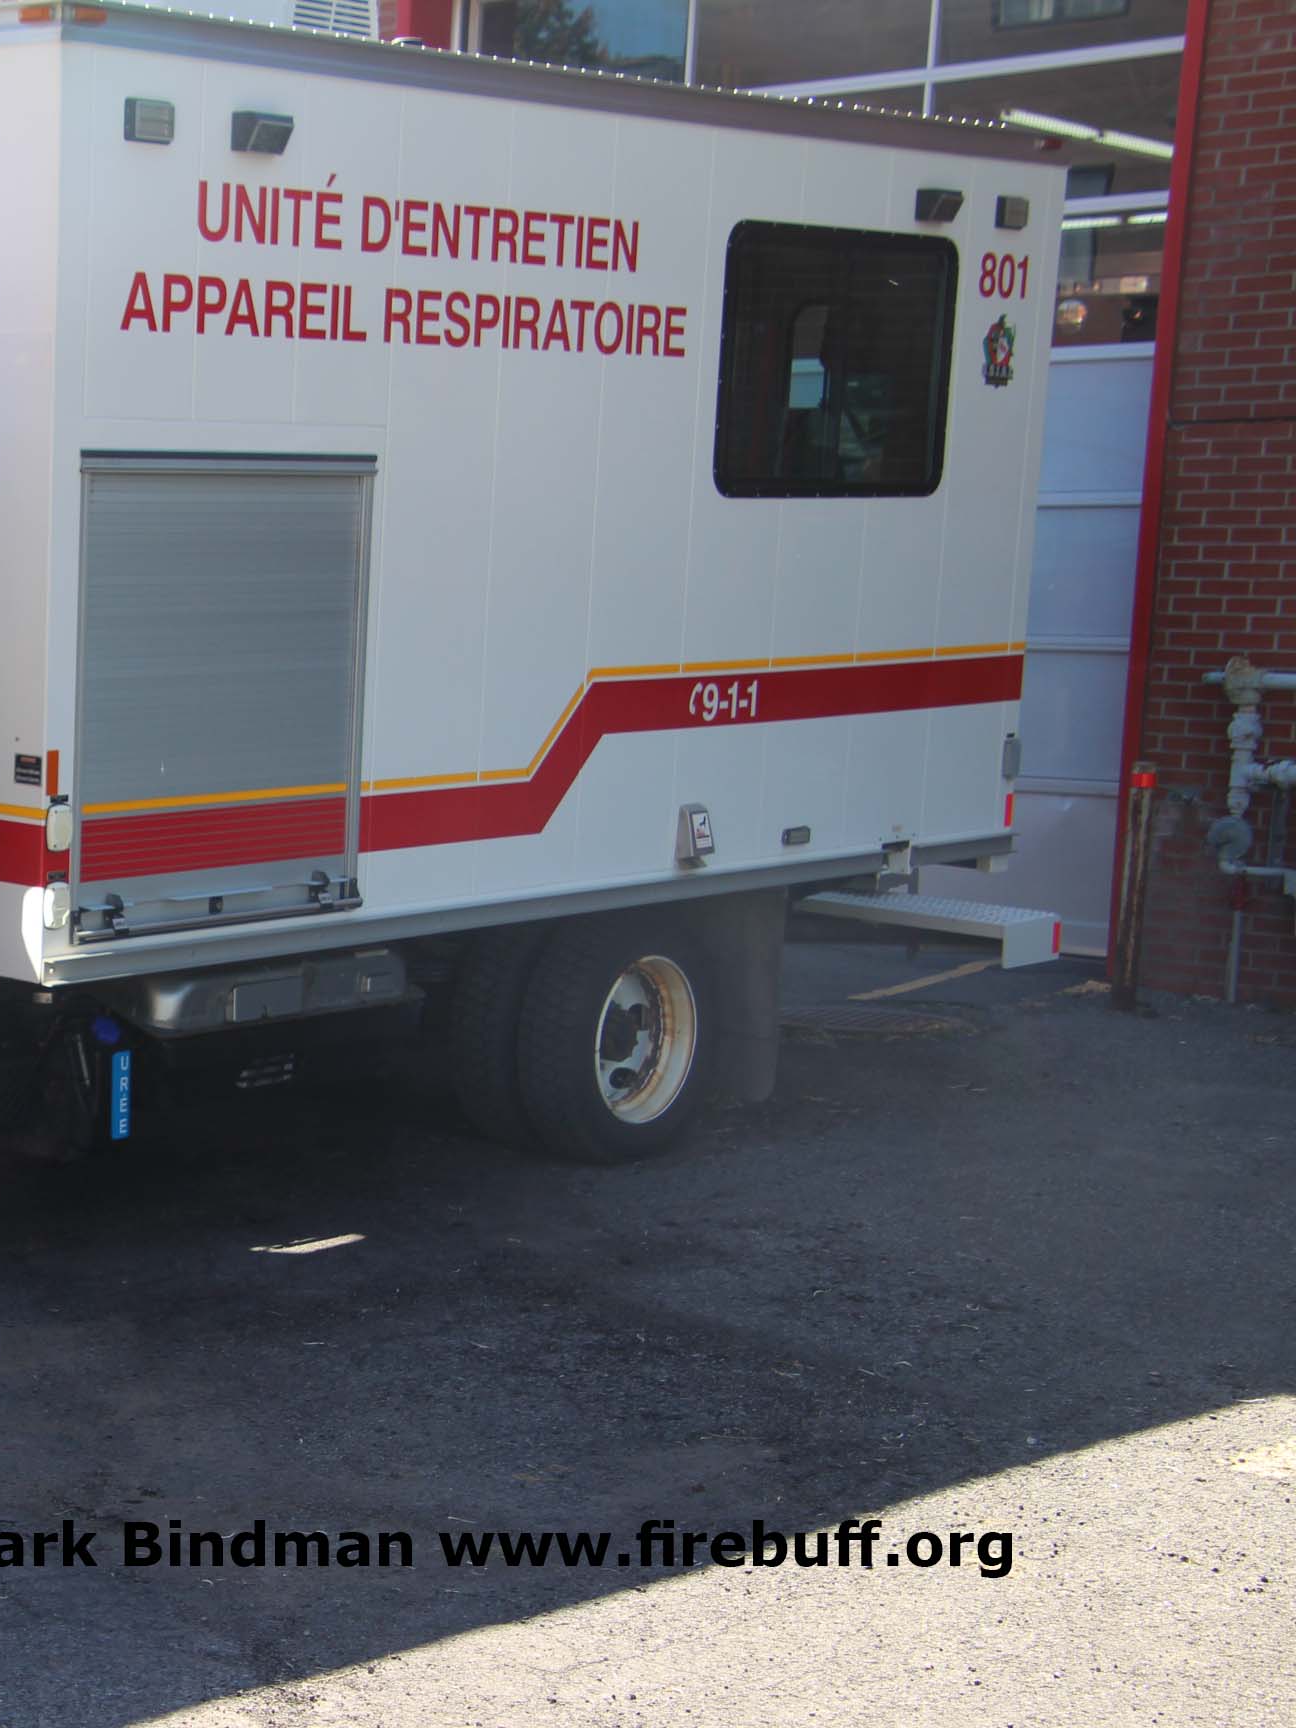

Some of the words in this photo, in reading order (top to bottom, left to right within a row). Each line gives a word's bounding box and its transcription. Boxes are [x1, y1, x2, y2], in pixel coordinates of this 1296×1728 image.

[196, 173, 344, 250] UNITÉ
[361, 196, 640, 273] D'ENTRETIEN
[120, 270, 367, 342] APPAREIL
[383, 287, 688, 357] RESPIRATOIRE
[978, 252, 1030, 300] 801
